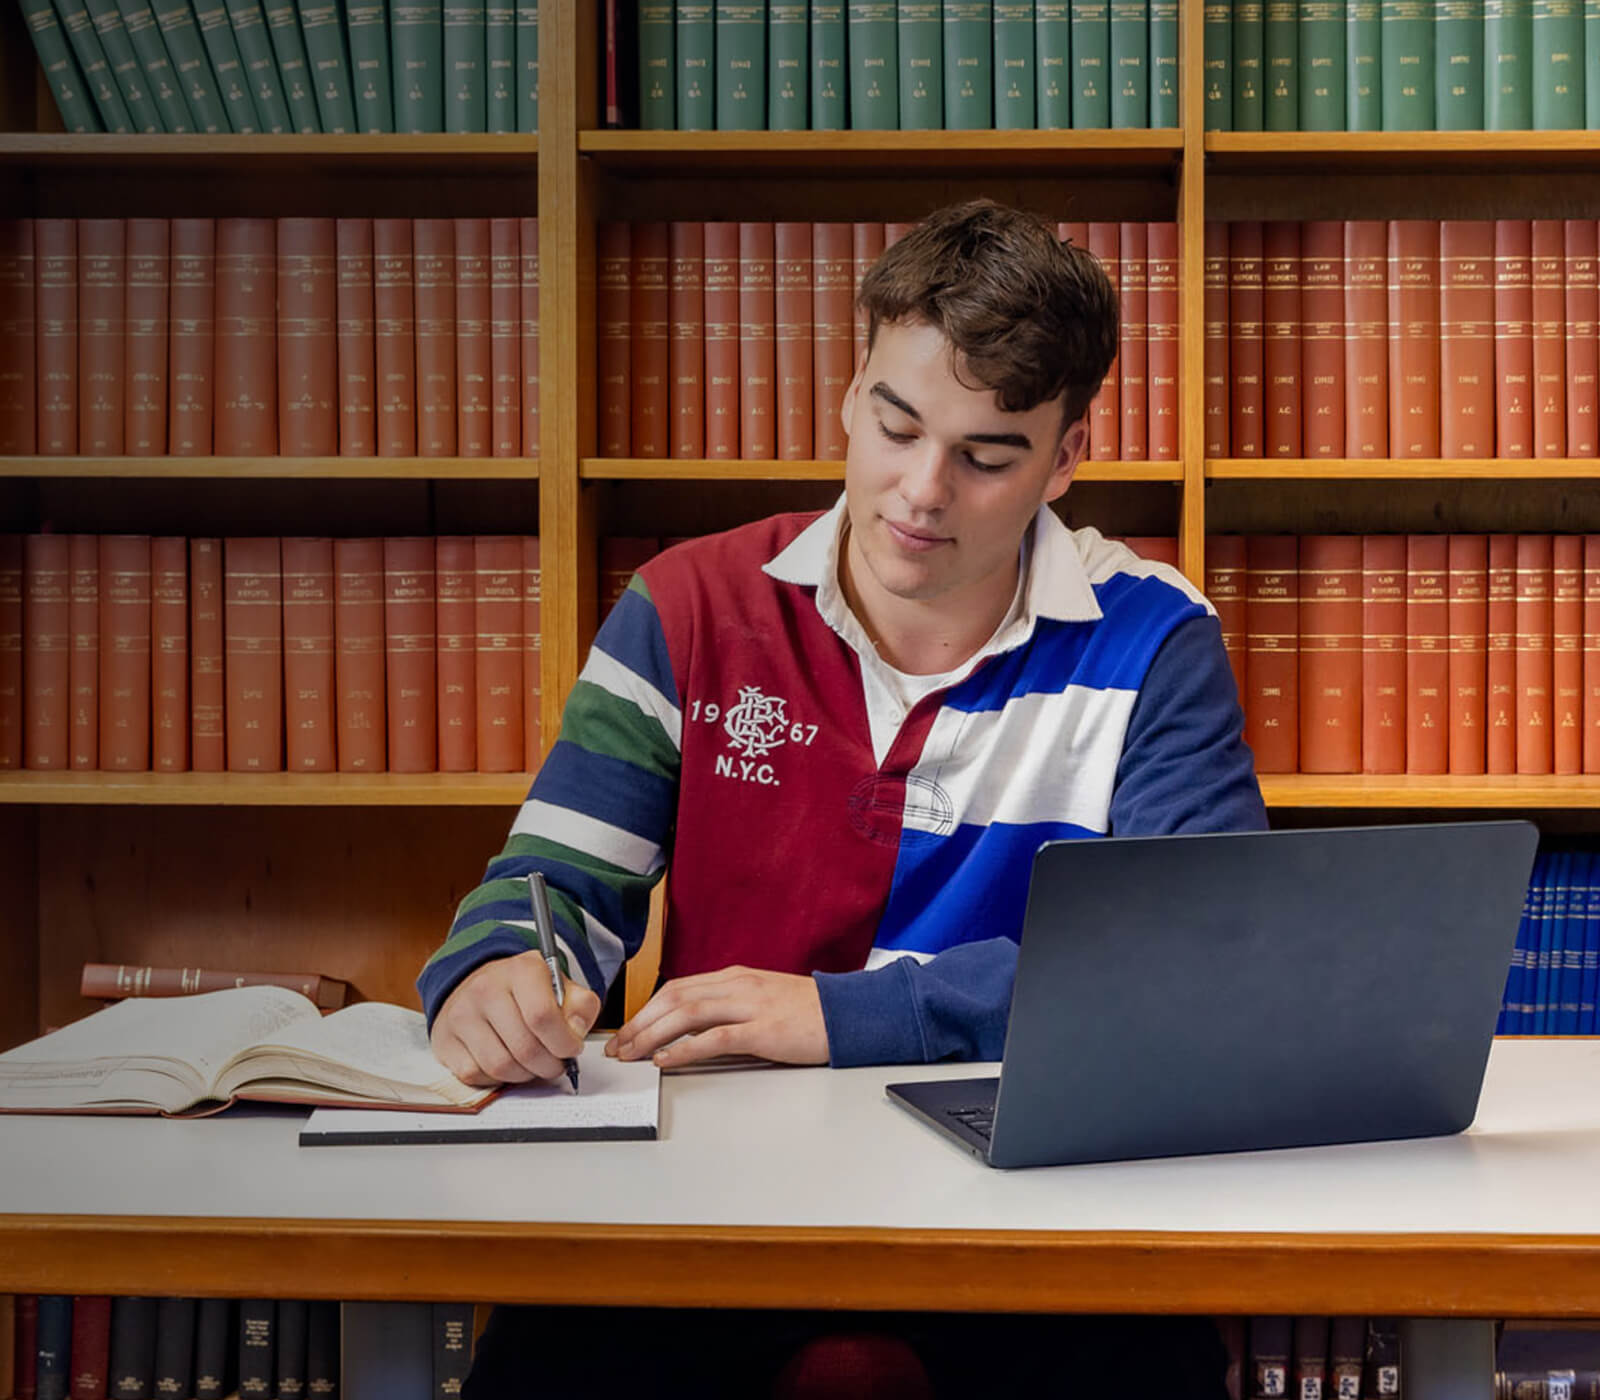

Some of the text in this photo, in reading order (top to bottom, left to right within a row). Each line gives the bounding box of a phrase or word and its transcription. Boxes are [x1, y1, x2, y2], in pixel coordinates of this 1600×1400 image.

[691, 700, 721, 723] 19
[789, 723, 819, 747] 67
[714, 754, 781, 786] N.Y.C.
